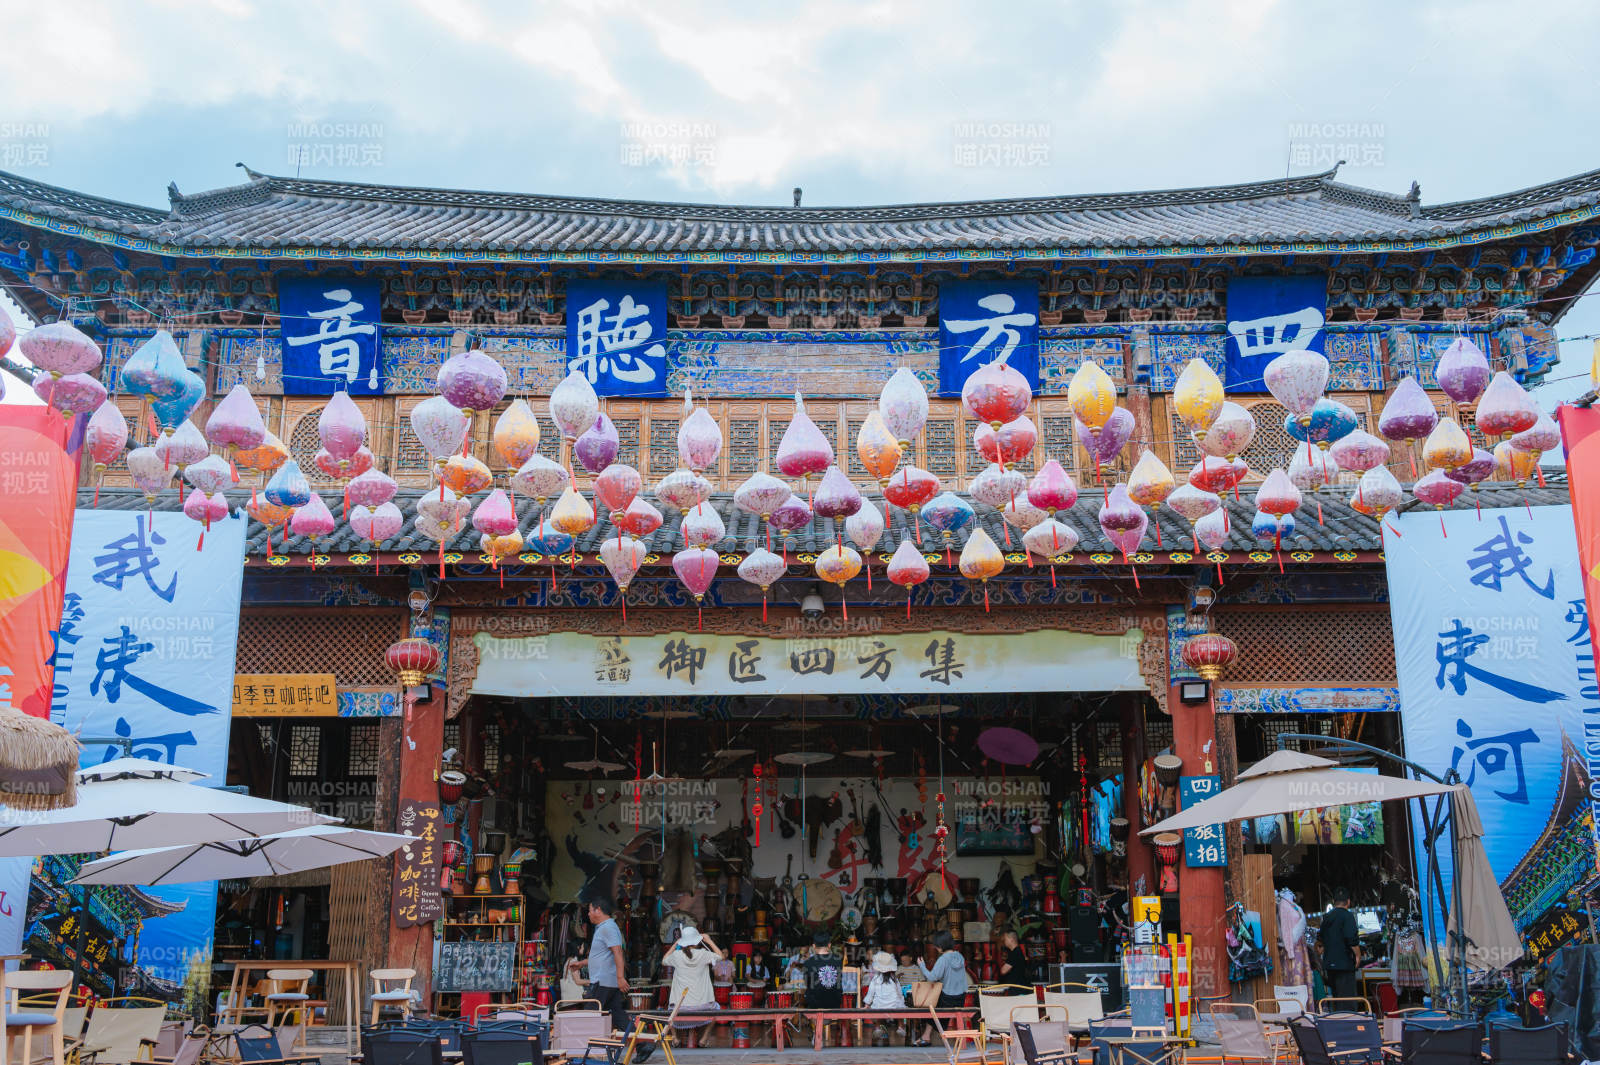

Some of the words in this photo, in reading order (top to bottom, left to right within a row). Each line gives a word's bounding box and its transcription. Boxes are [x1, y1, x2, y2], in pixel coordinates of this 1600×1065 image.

[287, 289, 376, 384] 音
[942, 293, 1037, 369] 方
[1227, 306, 1326, 358] 四
[658, 637, 964, 685] 御匠四方集
[418, 807, 439, 865] 四季豆
[1191, 779, 1218, 864] 四旅拍
[399, 865, 421, 921] 咖啡吧
